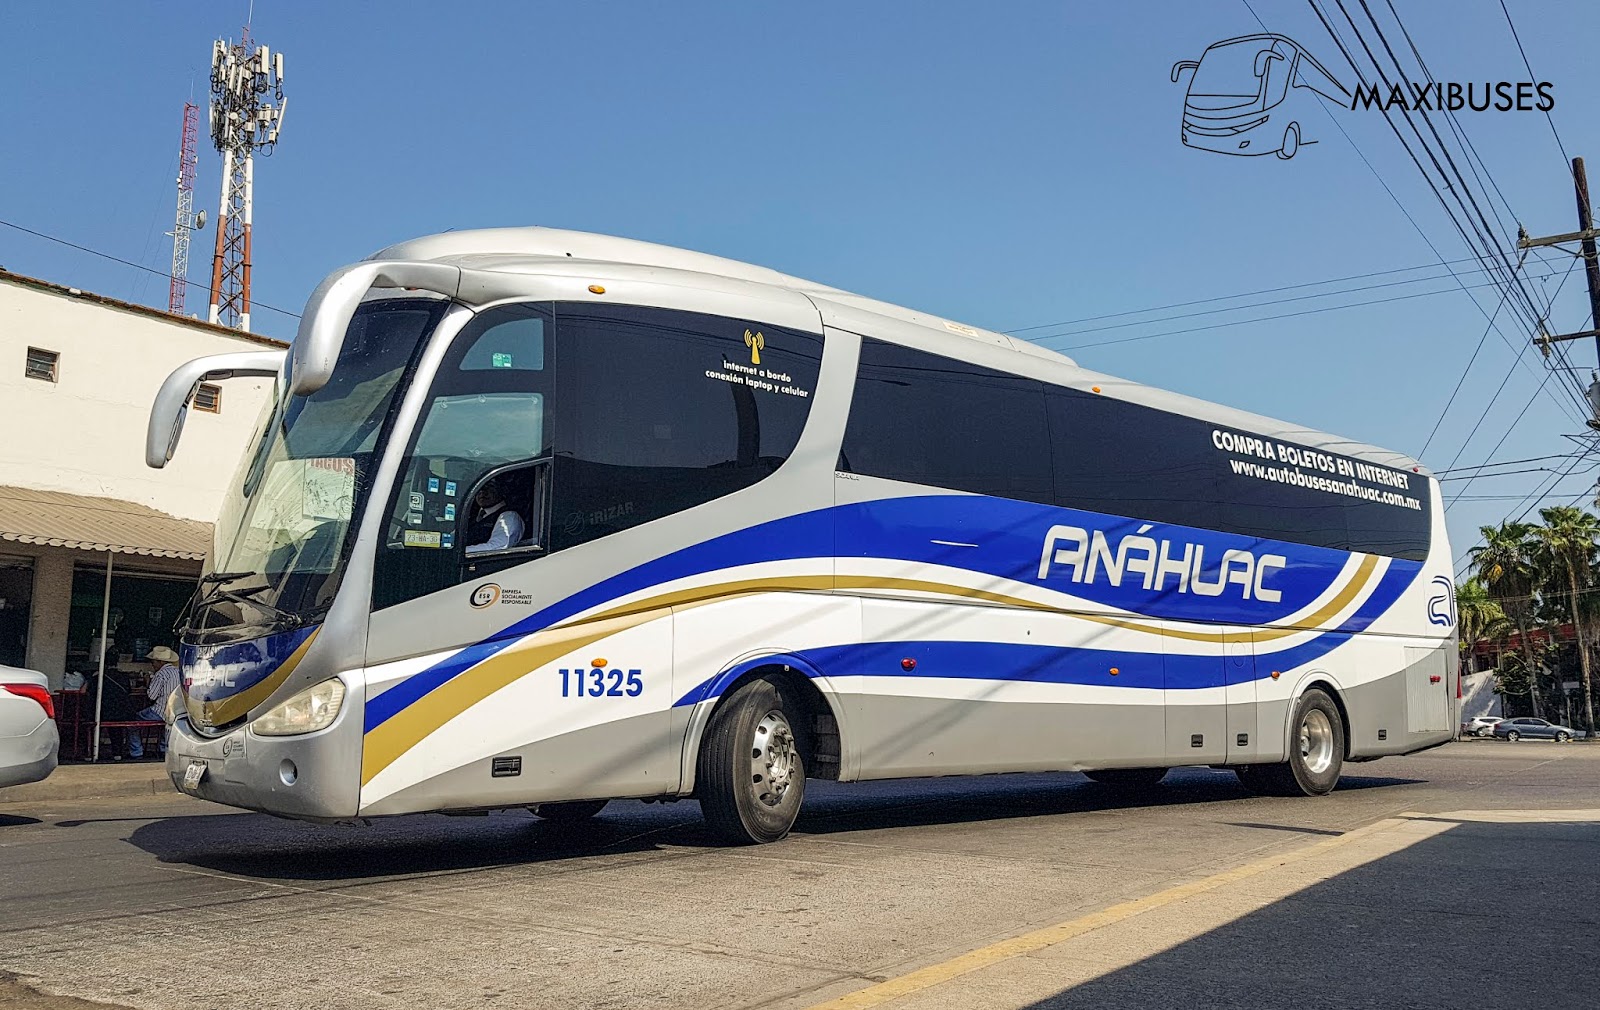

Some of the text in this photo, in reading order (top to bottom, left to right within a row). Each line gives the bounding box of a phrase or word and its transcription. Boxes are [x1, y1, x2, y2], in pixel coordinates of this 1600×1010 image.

[705, 370, 809, 398] conexión laptop y celular
[723, 360, 791, 383] internet a bordo
[1212, 430, 1409, 490] COMPRA BOLETOS EN INTERNET
[1229, 459, 1422, 511] www.autobusesanahuac.com.mx
[1037, 524, 1287, 603] ANÁHUAC
[558, 668, 643, 697] 11325
